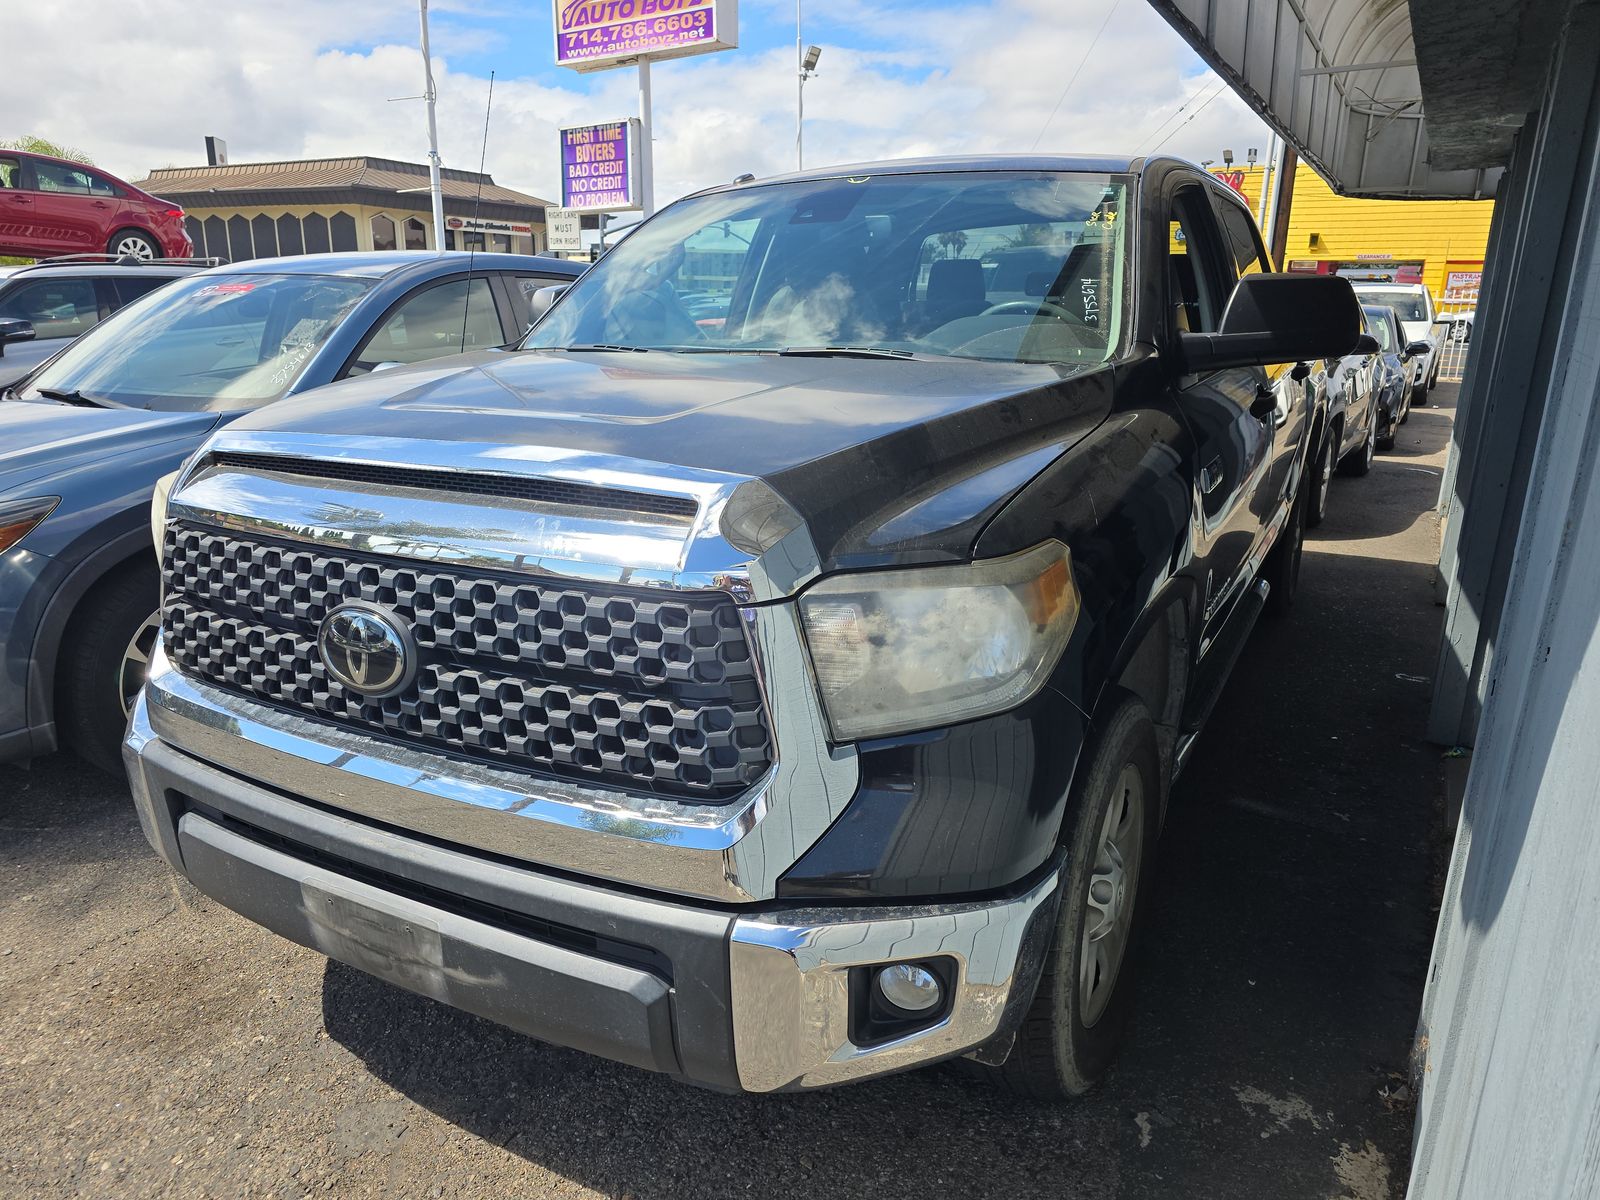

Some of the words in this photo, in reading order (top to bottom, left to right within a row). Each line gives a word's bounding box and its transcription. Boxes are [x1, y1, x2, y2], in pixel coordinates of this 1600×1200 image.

[574, 0, 635, 26] AUTO
[566, 11, 707, 48] 714.786.6603
[566, 28, 705, 58] www.autoboyz.net
[567, 128, 594, 145] FIRST
[597, 124, 622, 141] TIME
[575, 142, 616, 163] BUYERS
[569, 163, 589, 178] BAD
[591, 160, 624, 176] CREDIT
[571, 179, 588, 193] NO
[589, 175, 622, 190] CREDIT
[570, 194, 585, 207] NO
[586, 191, 625, 207] PROBLEM
[548, 211, 562, 219] RIGHT
[564, 211, 577, 219] LANE
[554, 223, 573, 233] MUST
[550, 237, 564, 245] TURN
[564, 237, 579, 245] RIGHT
